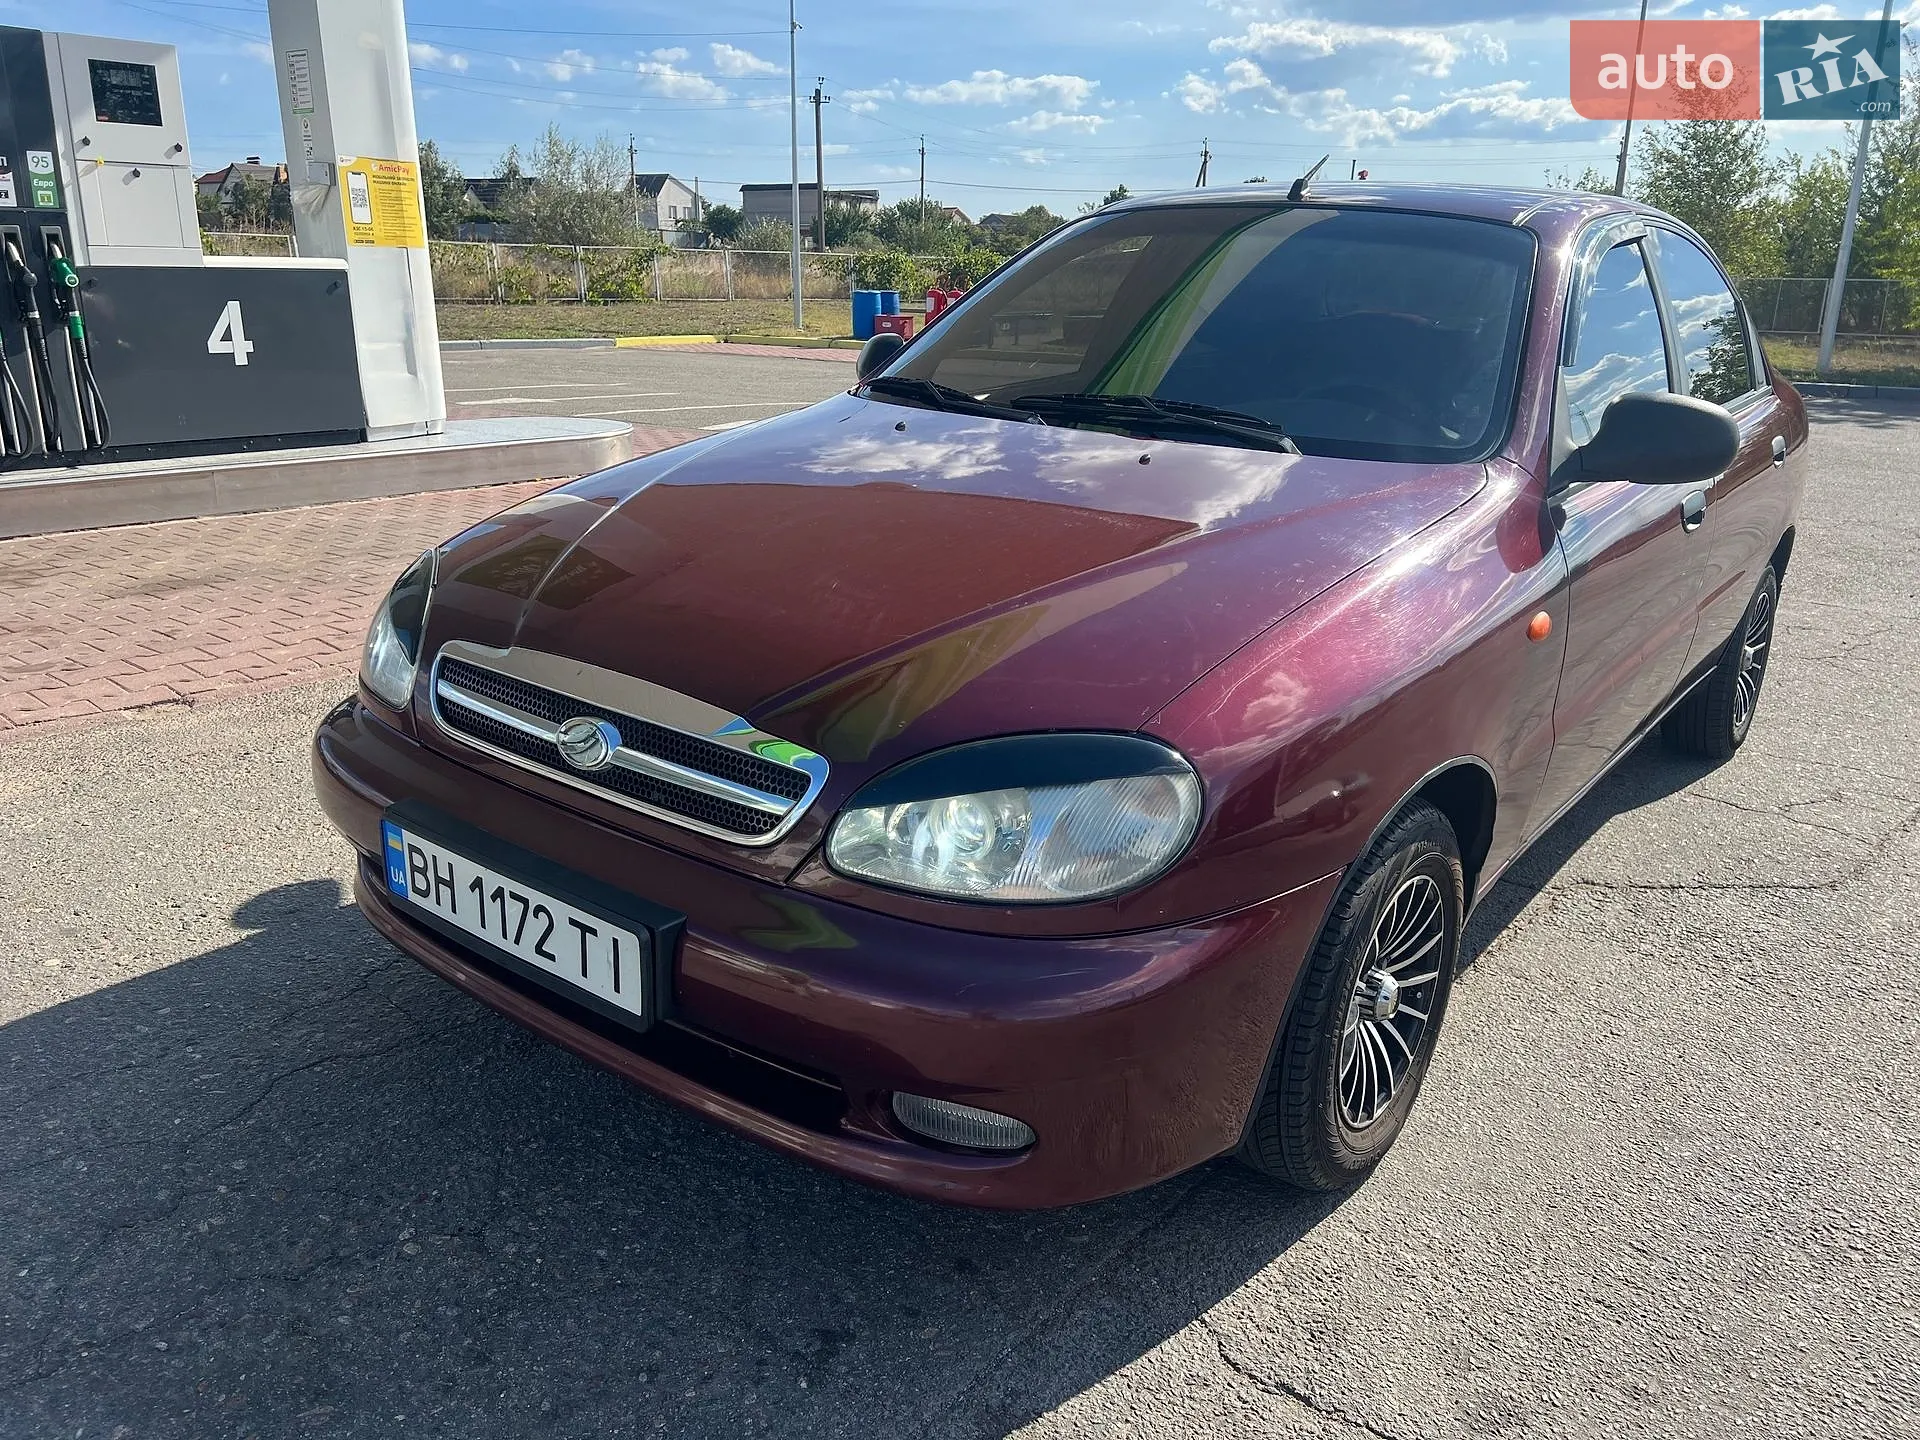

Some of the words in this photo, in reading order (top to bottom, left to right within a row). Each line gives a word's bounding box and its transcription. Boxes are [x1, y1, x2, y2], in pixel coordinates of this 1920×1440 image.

[32, 156, 49, 168] 95
[378, 164, 410, 175] AmicPay
[207, 300, 255, 366] 4
[390, 865, 406, 887] UA
[407, 842, 458, 915] BH
[469, 875, 557, 963] 1172
[568, 916, 621, 995] TI
